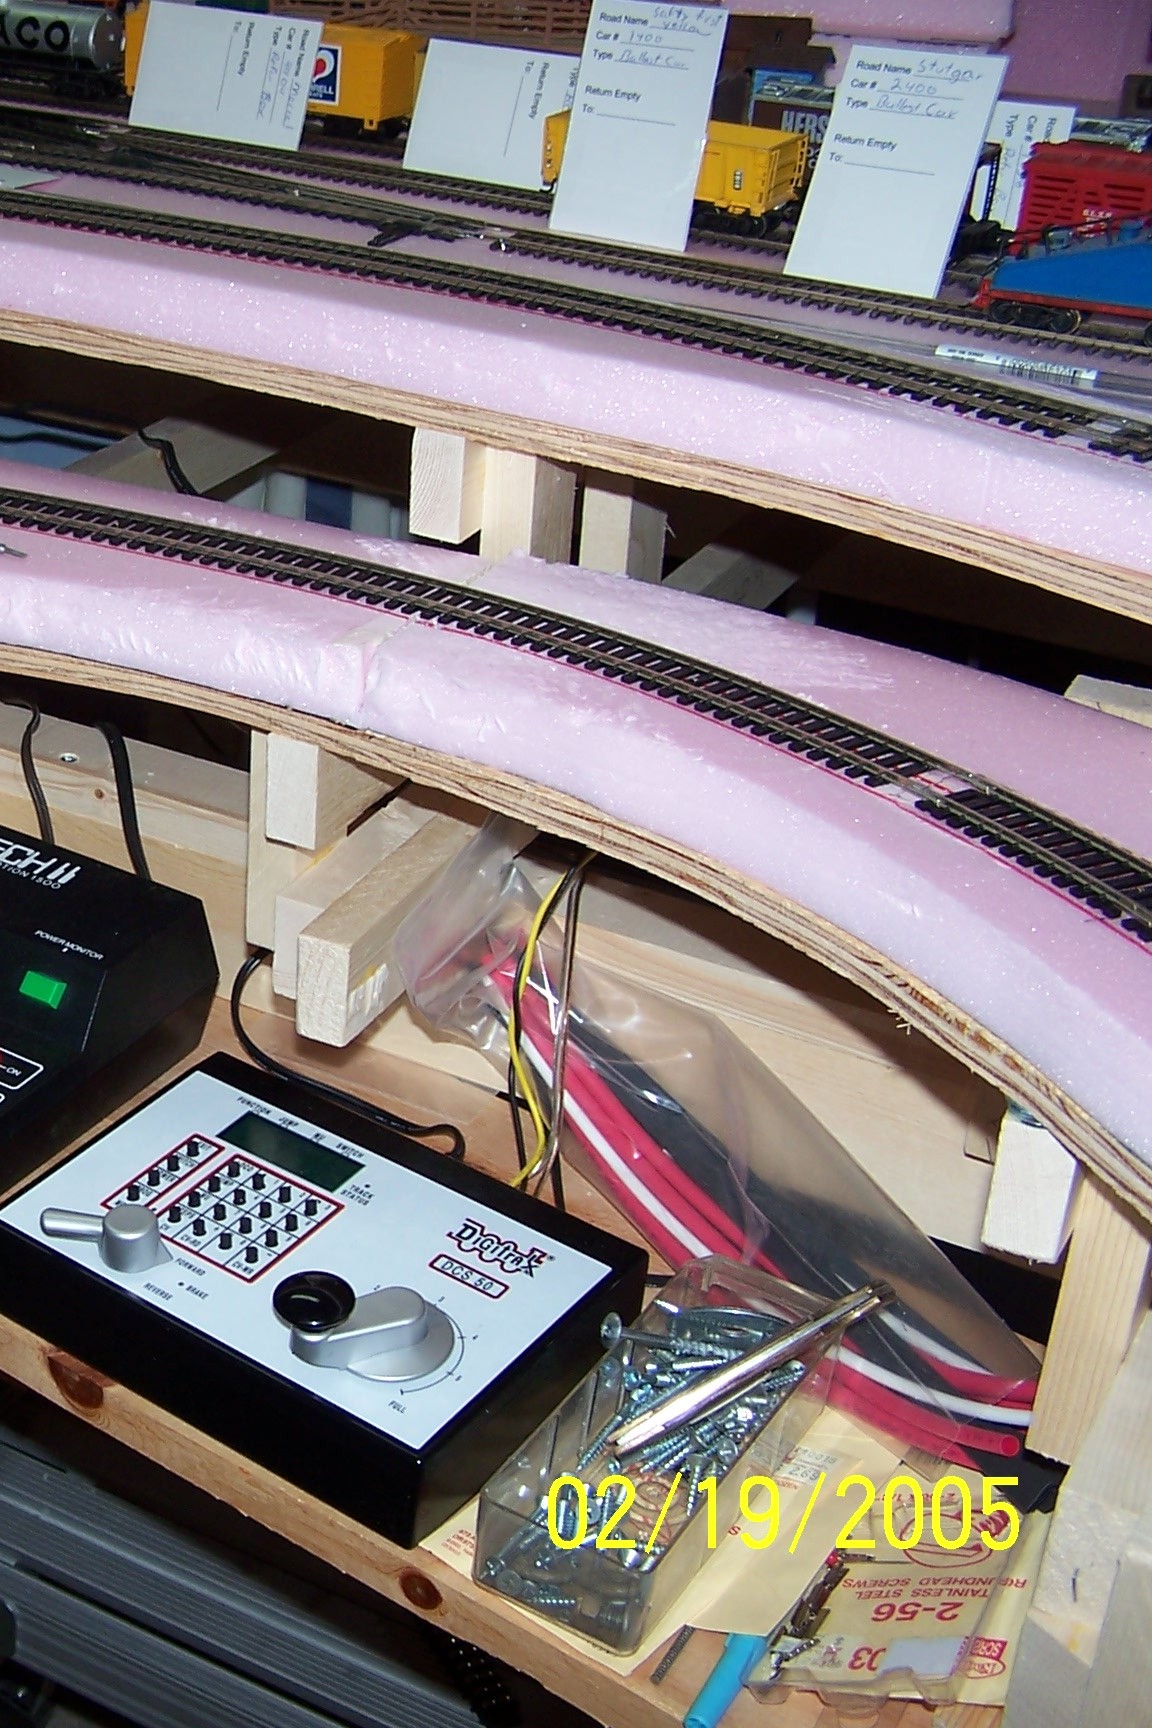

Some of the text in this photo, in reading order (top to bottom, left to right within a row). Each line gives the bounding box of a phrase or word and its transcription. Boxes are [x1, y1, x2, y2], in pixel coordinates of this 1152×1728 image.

[599, 12, 622, 24] Road
[623, 15, 649, 26] Name
[272, 26, 283, 47] Type
[287, 27, 297, 44] Car
[301, 29, 311, 52] Road
[596, 32, 612, 41] Car
[237, 22, 256, 76] Return Empty
[592, 49, 613, 61] Type
[294, 52, 306, 77] Name
[856, 60, 882, 72] Road
[883, 63, 912, 75] Name
[529, 63, 550, 120] Return Empty
[585, 85, 642, 103] Return Empty
[850, 78, 869, 89] Car
[889, 78, 938, 95] 2400
[846, 98, 869, 109] Type
[1004, 114, 1019, 138] Type
[1026, 115, 1038, 134] Car
[834, 133, 898, 151] Return Empty
[34, 930, 104, 960] POWER MONITOR
[6, 1065, 22, 1077] ON
[237, 1096, 272, 1116] FUNCTION
[335, 1142, 365, 1158] SWITCH
[340, 1190, 370, 1206] STATUS
[349, 1184, 374, 1200] TRACK
[175, 1257, 206, 1277] FORWARD
[440, 1261, 494, 1291] DCS 50
[143, 1282, 174, 1301] REVERSE
[186, 1284, 209, 1300] BRAKE
[388, 1400, 407, 1414] FULL
[841, 1577, 911, 1589] SCREWS
[855, 1588, 990, 1600] TAINLESS STEEL
[870, 1601, 964, 1623] 2-56
